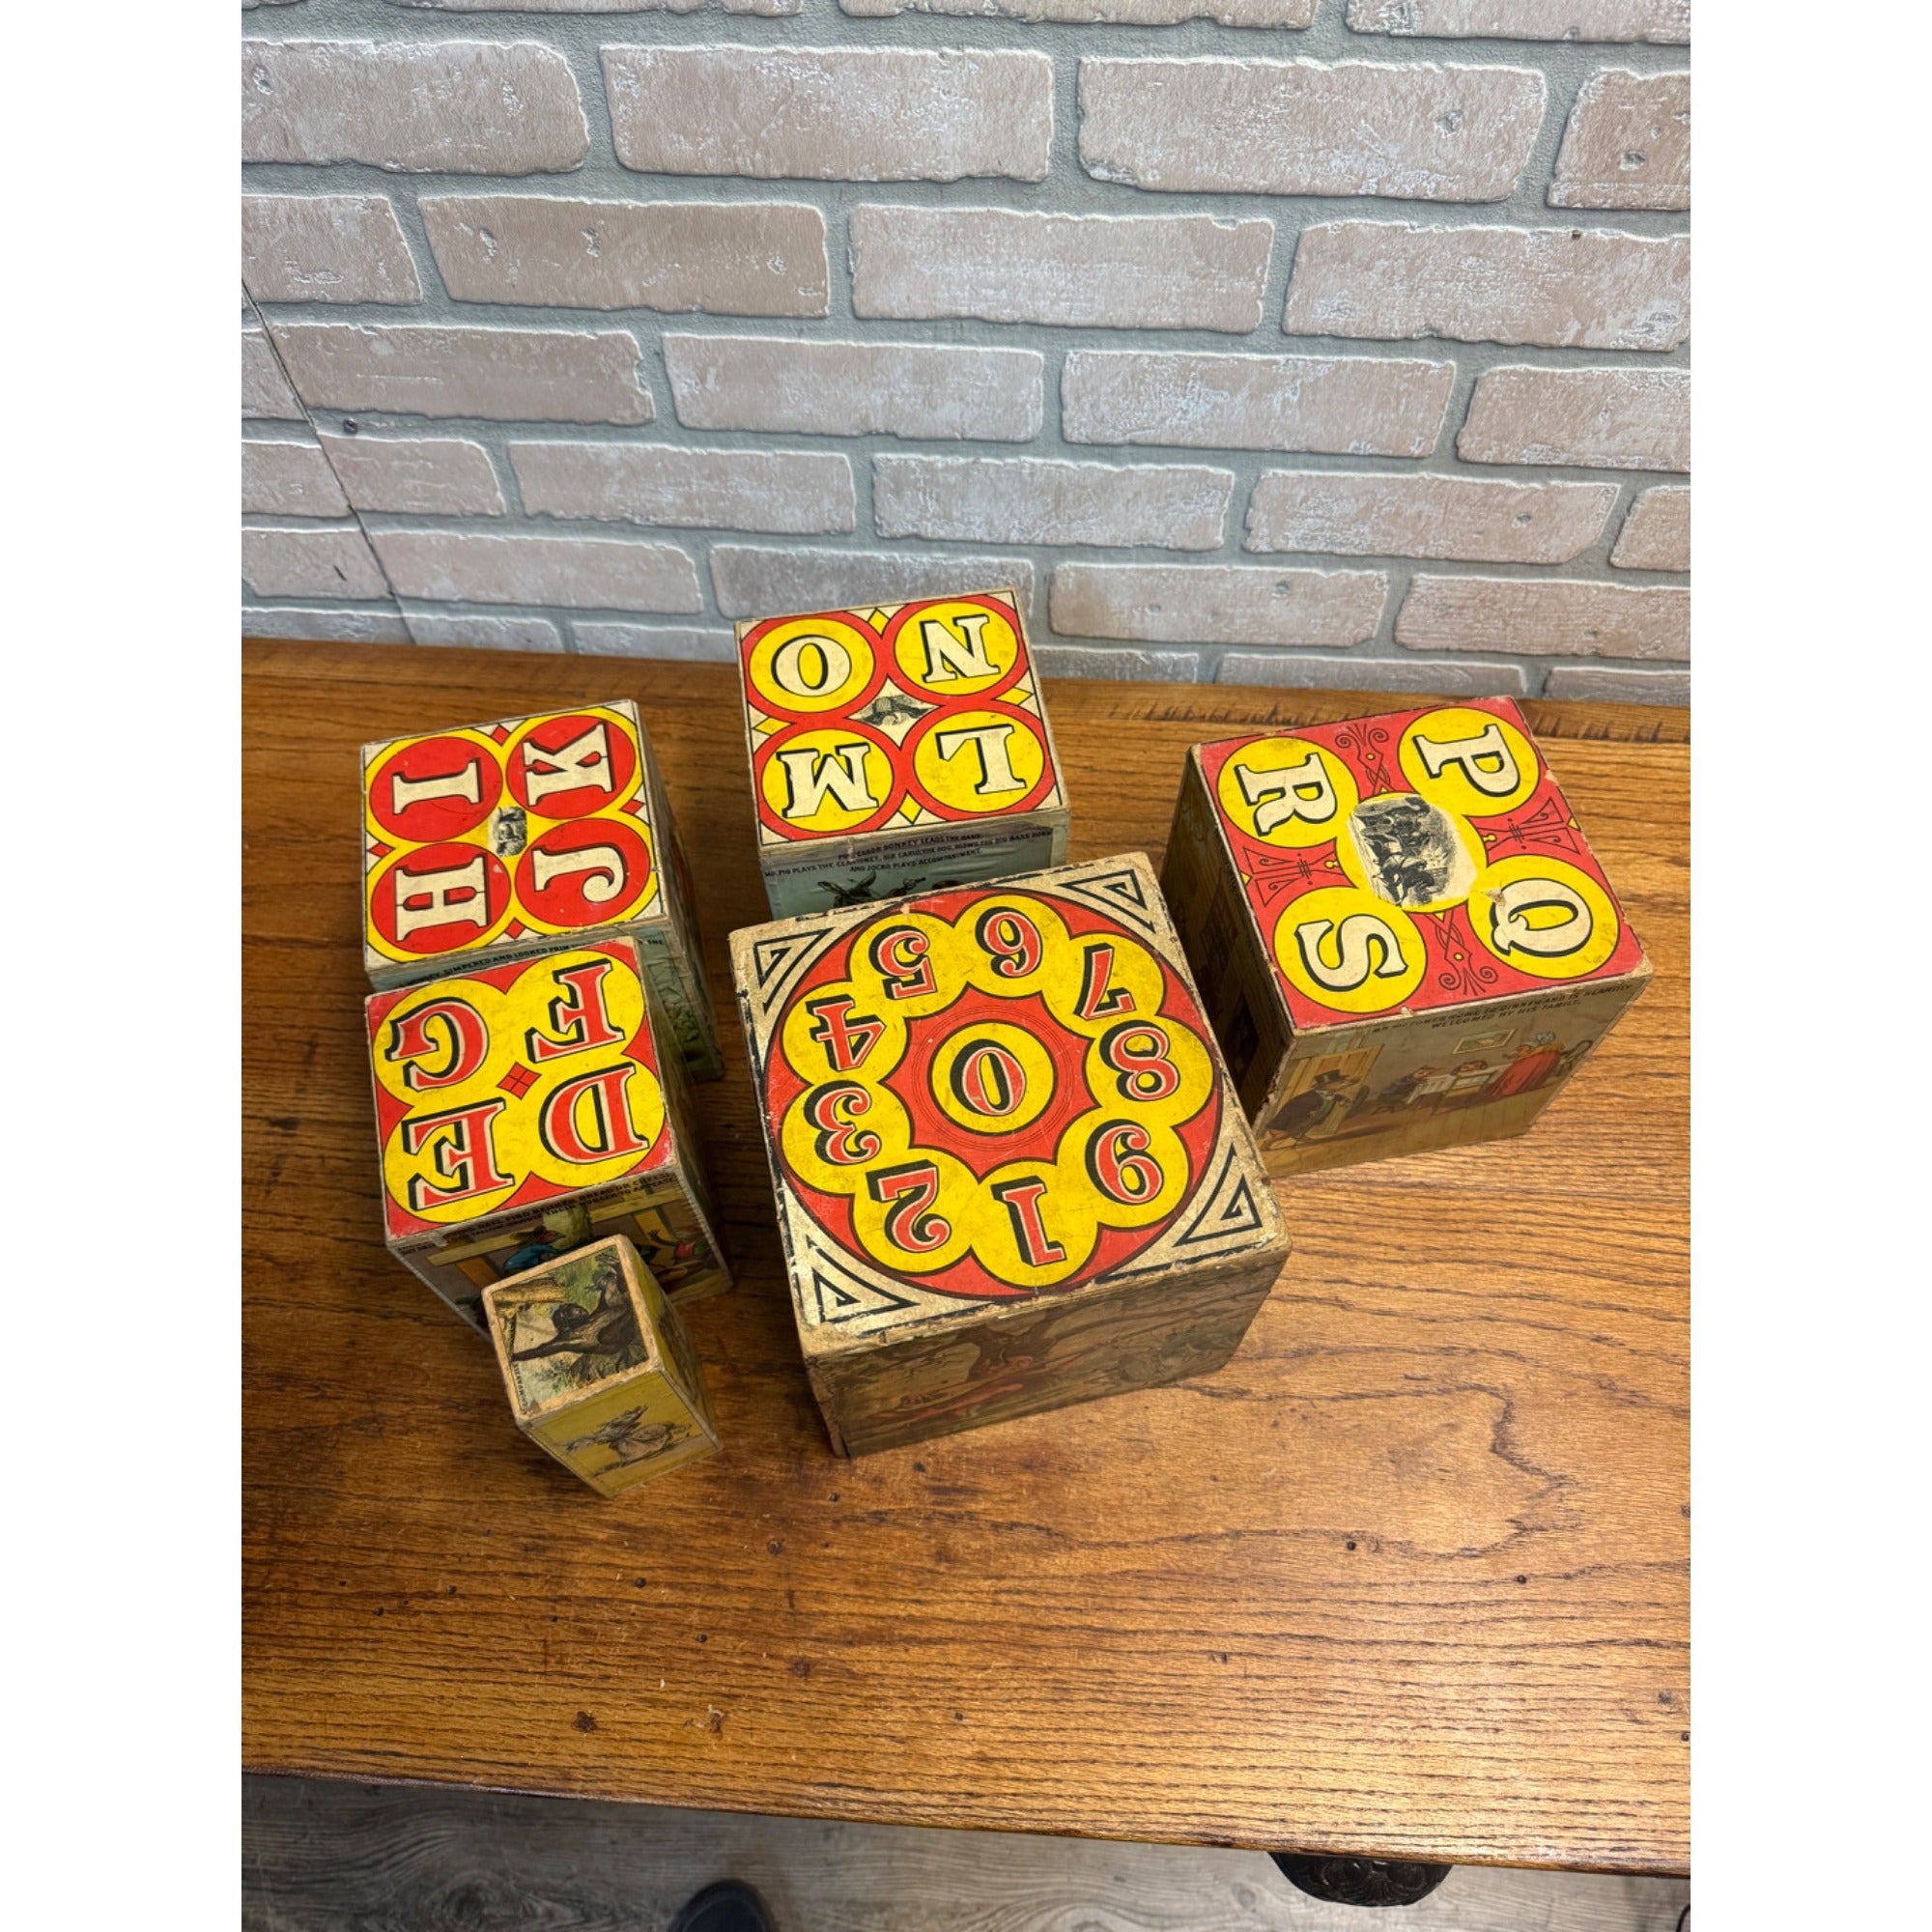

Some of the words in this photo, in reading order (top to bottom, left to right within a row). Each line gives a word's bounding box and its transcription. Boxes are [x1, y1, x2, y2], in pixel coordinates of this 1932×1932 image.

[772, 634, 852, 697] O
[920, 614, 1001, 684] N
[392, 757, 481, 816] I
[522, 722, 616, 806] K
[777, 743, 880, 820] M
[935, 724, 1027, 796] L
[1234, 753, 1338, 837] R
[1412, 724, 1520, 798] P
[394, 852, 489, 943] H
[531, 845, 627, 903] J
[976, 906, 1044, 978] 6
[1294, 913, 1408, 992] S
[1490, 877, 1593, 958] Q
[869, 924, 937, 1000] 5
[1074, 944, 1138, 1021] 7
[384, 997, 490, 1093] G
[525, 958, 625, 1064] F
[806, 996, 885, 1072] 4
[950, 1038, 1027, 1117] 0
[1099, 1020, 1180, 1102] 8
[538, 1062, 650, 1165] D
[803, 1079, 882, 1165] 3
[402, 1097, 516, 1212] E
[1086, 1119, 1165, 1206] 9
[870, 1160, 952, 1253] 2
[991, 1176, 1066, 1267] 1
